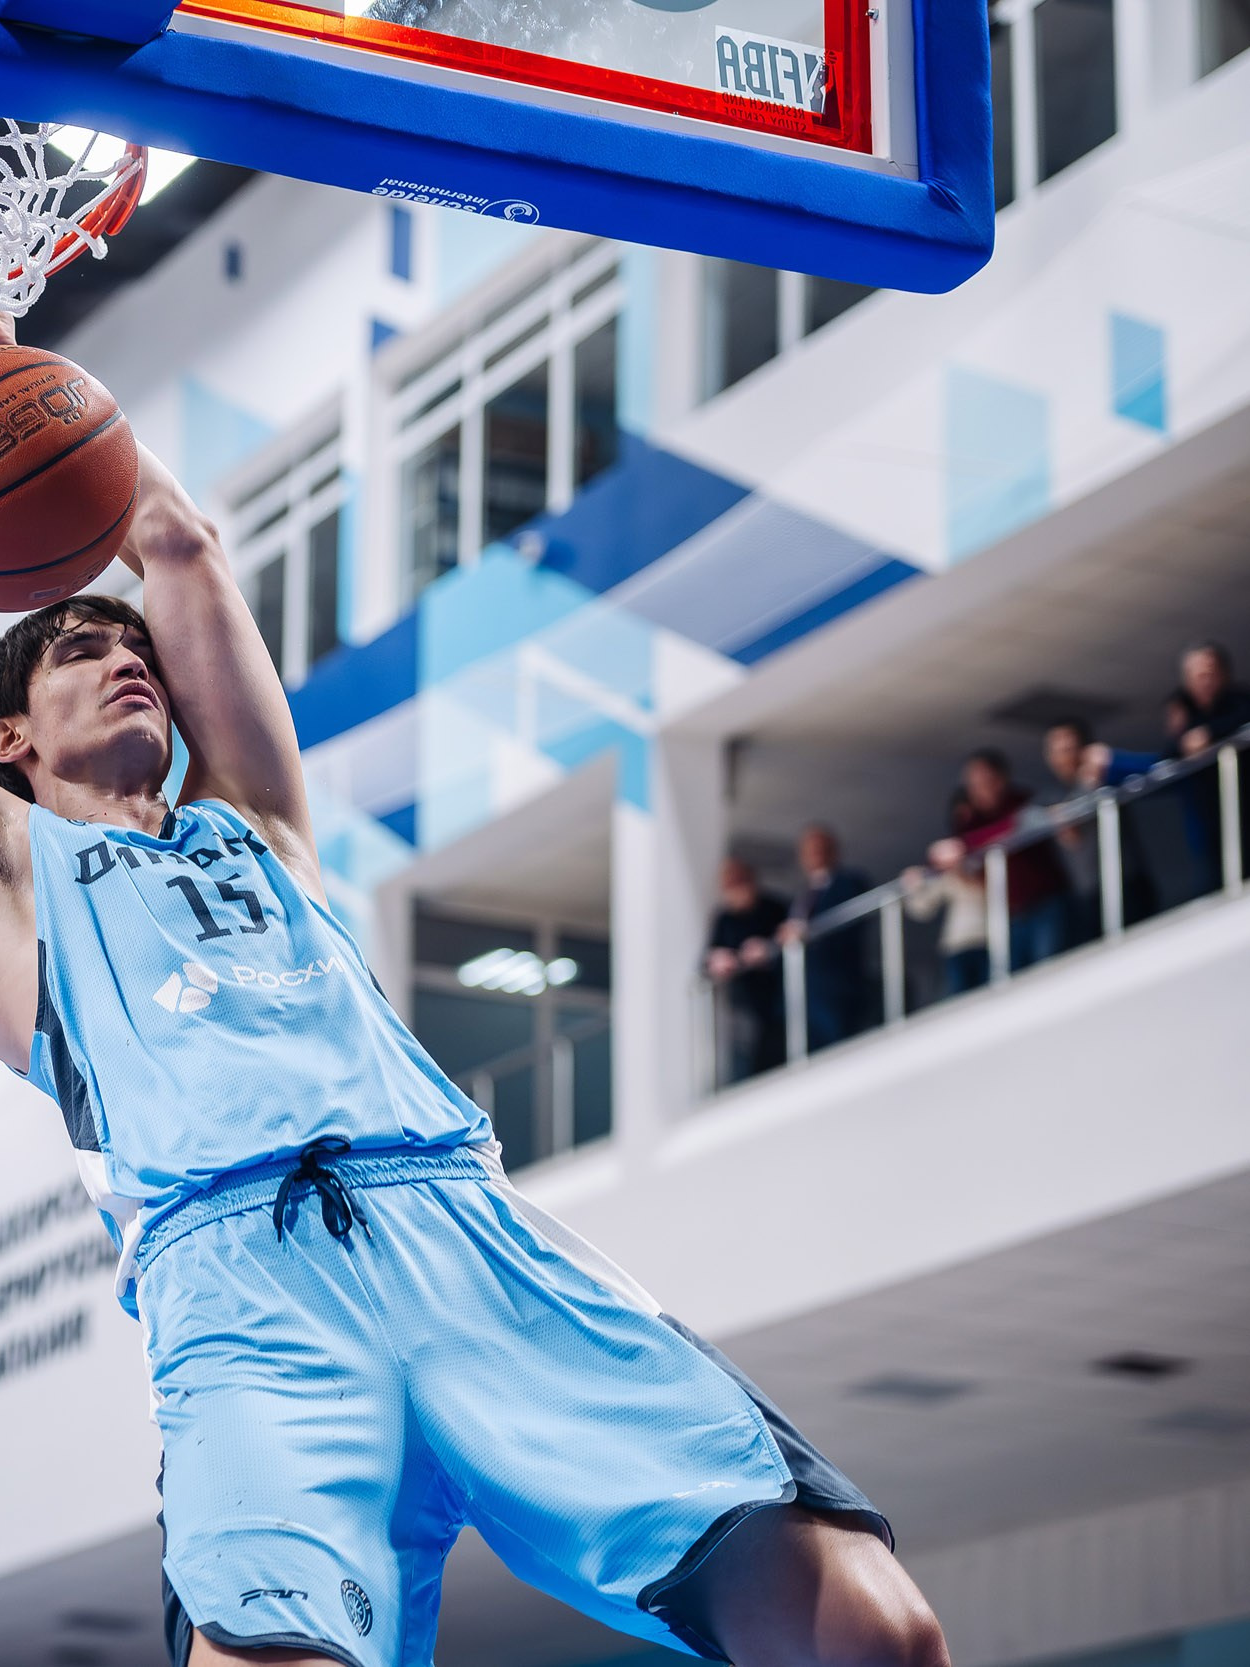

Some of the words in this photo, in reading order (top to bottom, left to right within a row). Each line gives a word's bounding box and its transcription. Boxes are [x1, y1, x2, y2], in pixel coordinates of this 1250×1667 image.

[379, 177, 489, 207] international
[18, 374, 57, 396] OFFICIAL
[165, 872, 269, 943] 15
